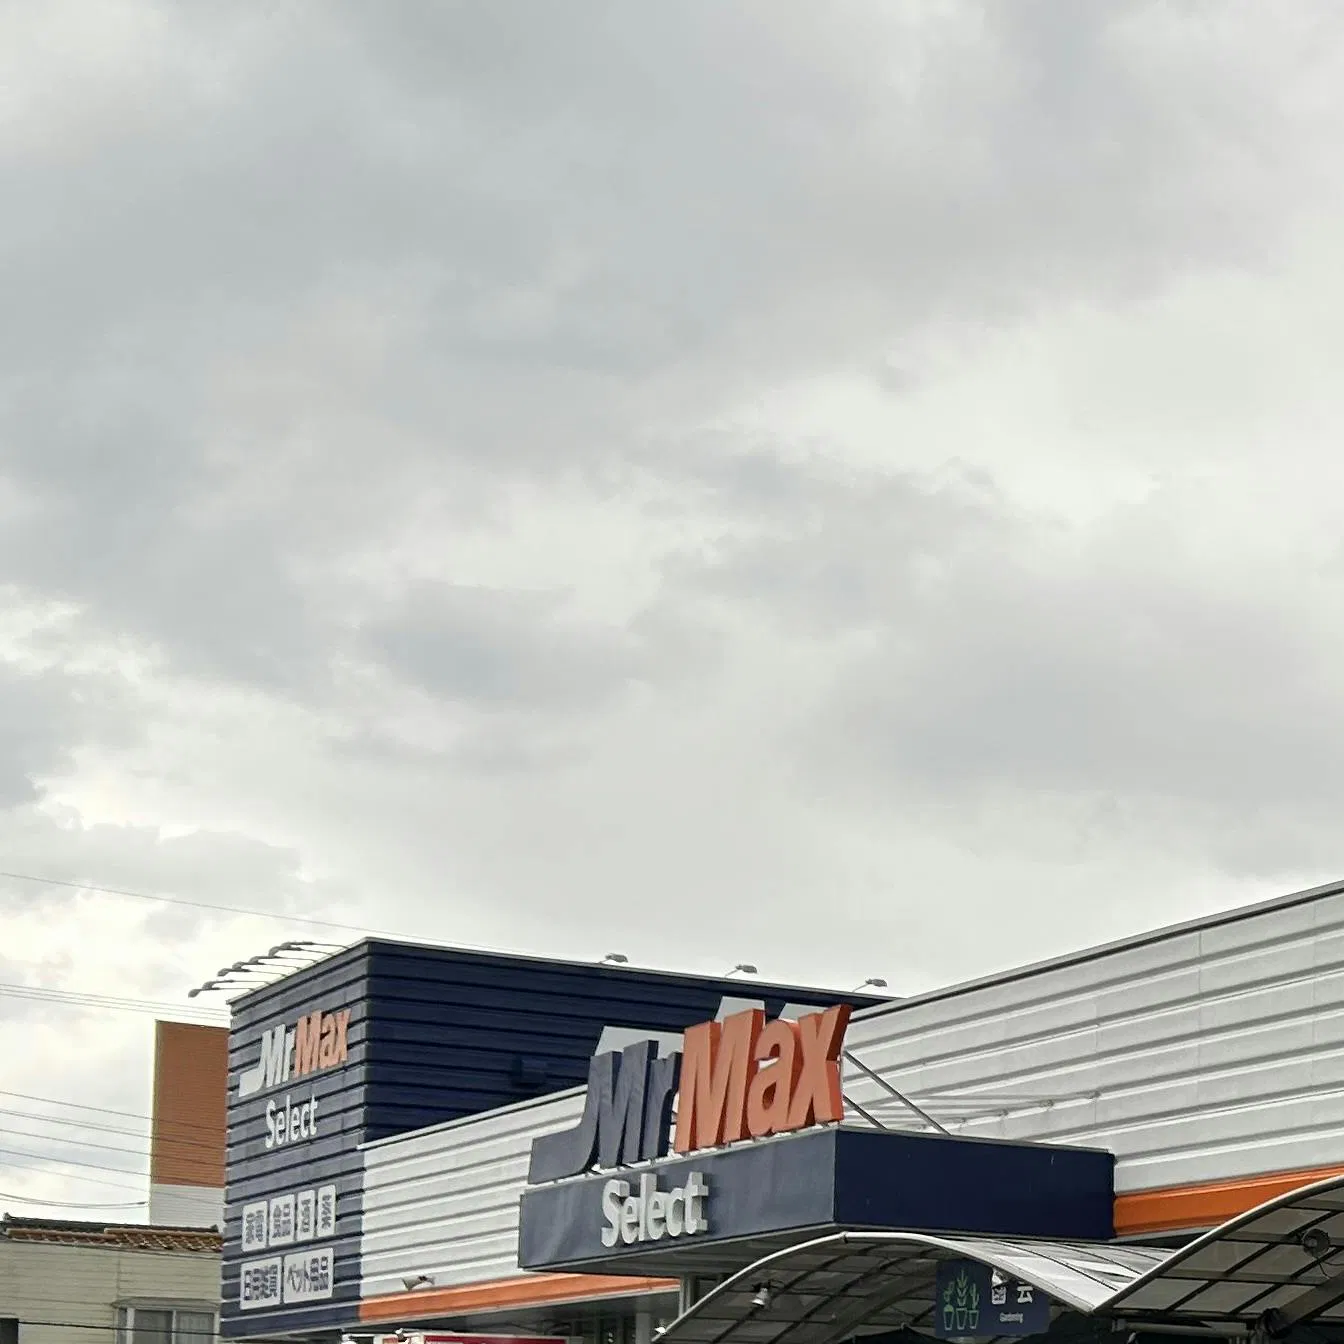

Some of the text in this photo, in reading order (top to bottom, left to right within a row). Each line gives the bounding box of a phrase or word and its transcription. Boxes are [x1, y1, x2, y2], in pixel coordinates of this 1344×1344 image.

[239, 1008, 351, 1097] MrMax
[529, 1004, 852, 1184] MrMax
[265, 1093, 318, 1148] Select
[600, 1171, 709, 1248] Select
